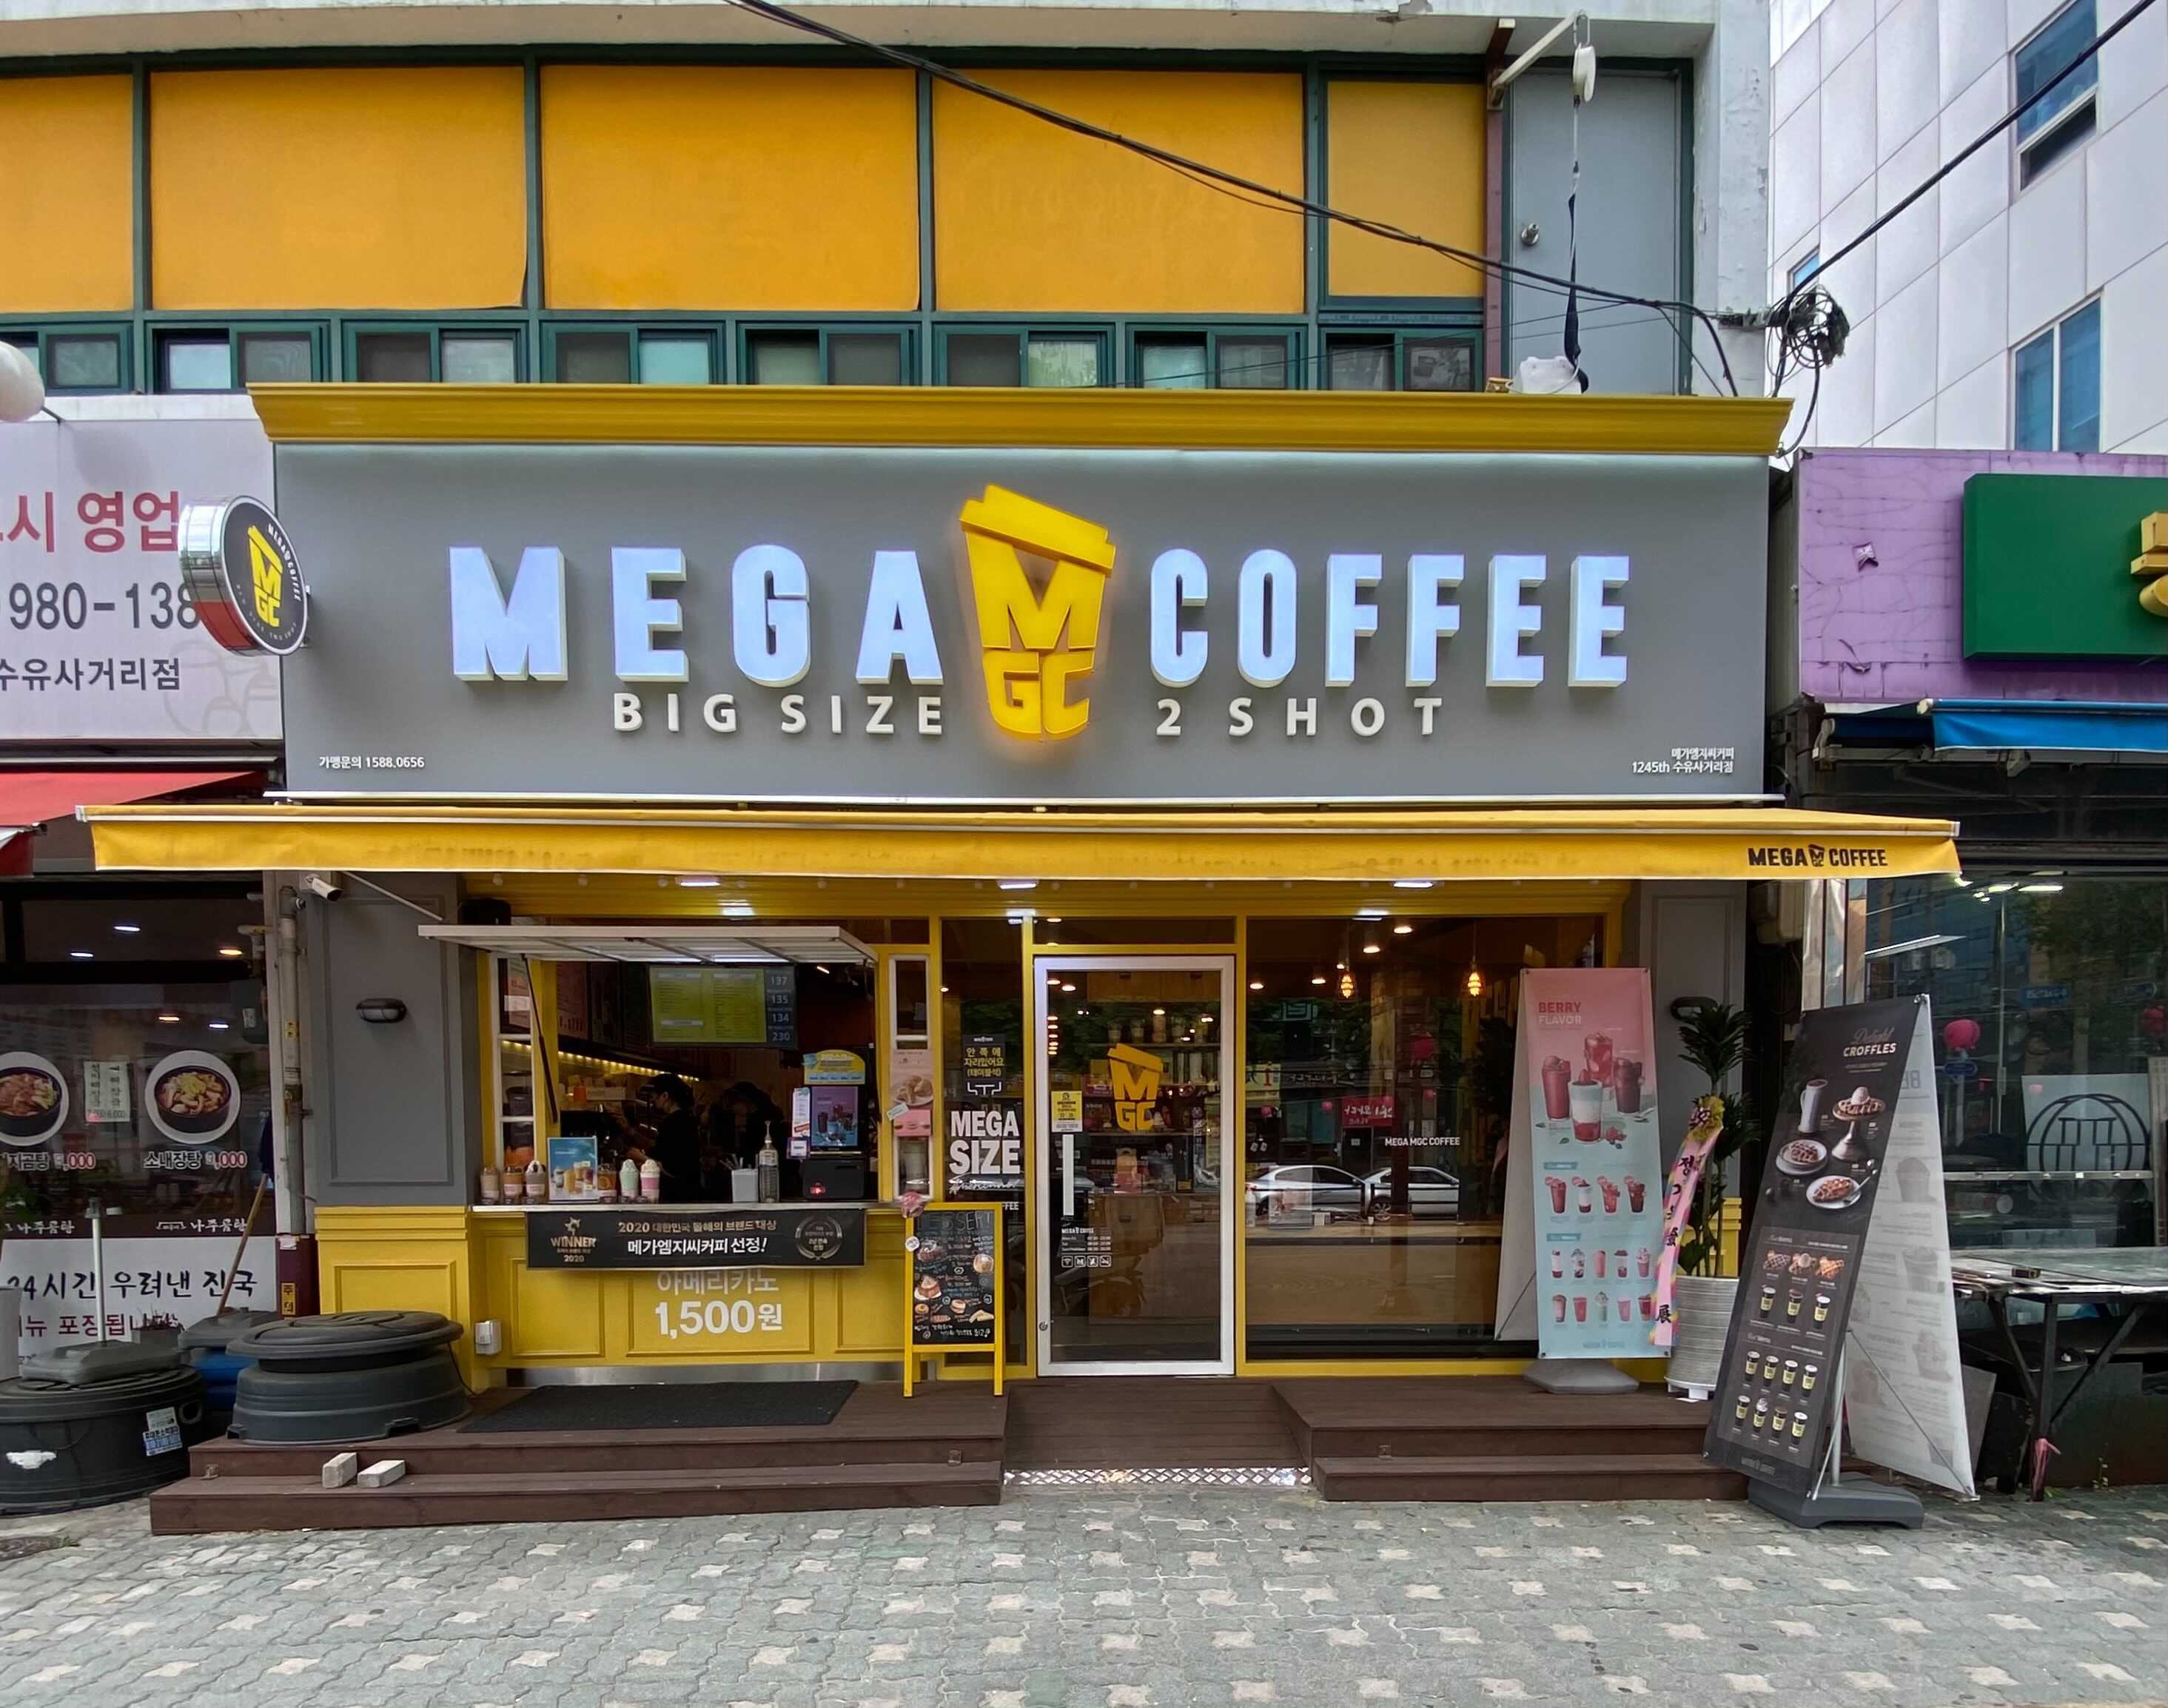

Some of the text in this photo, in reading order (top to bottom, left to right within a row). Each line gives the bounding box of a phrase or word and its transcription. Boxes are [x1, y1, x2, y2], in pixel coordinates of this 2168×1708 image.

[0, 491, 179, 553] 시 영업
[449, 545, 1630, 688] MEGA COFFEE
[0, 658, 181, 691] 수유사거리점
[614, 693, 1442, 736] BIG SIZE 2 SHOT
[319, 756, 425, 769] 가맹문의 1588.0656
[1631, 761, 1734, 773] 1245th 수유사거리점
[1748, 847, 1887, 867] MEGA COFFEE
[771, 976, 788, 986] 137
[771, 995, 788, 1004] 135
[1538, 1002, 1582, 1013] BERRY
[772, 1013, 789, 1023] 134
[1538, 1015, 1582, 1025] FLAVOR
[1843, 1043, 1896, 1058] CROFFLES
[950, 1111, 1020, 1137] MEGA
[1385, 1137, 1461, 1146] MEGA MGC COFFEE
[1, 1151, 50, 1171] 지곰탕
[144, 1150, 202, 1169] 소내장탕
[949, 1140, 1021, 1175] SIZE
[1002, 1201, 1019, 1211] FEE
[17, 1220, 75, 1234] 나주곰탕
[190, 1218, 247, 1233] 나주곰탕
[618, 1222, 650, 1233] 2020
[652, 1221, 691, 1233] 대한민국
[550, 1236, 597, 1248] WINNER
[627, 1237, 768, 1255] 메가엠지씨커피 선정!
[110, 1270, 192, 1299] 우려낸
[202, 1269, 258, 1298] 진국
[657, 1268, 779, 1295] 아메리카노
[19, 1314, 48, 1338] 뉴
[654, 1300, 782, 1339] 1,500원
